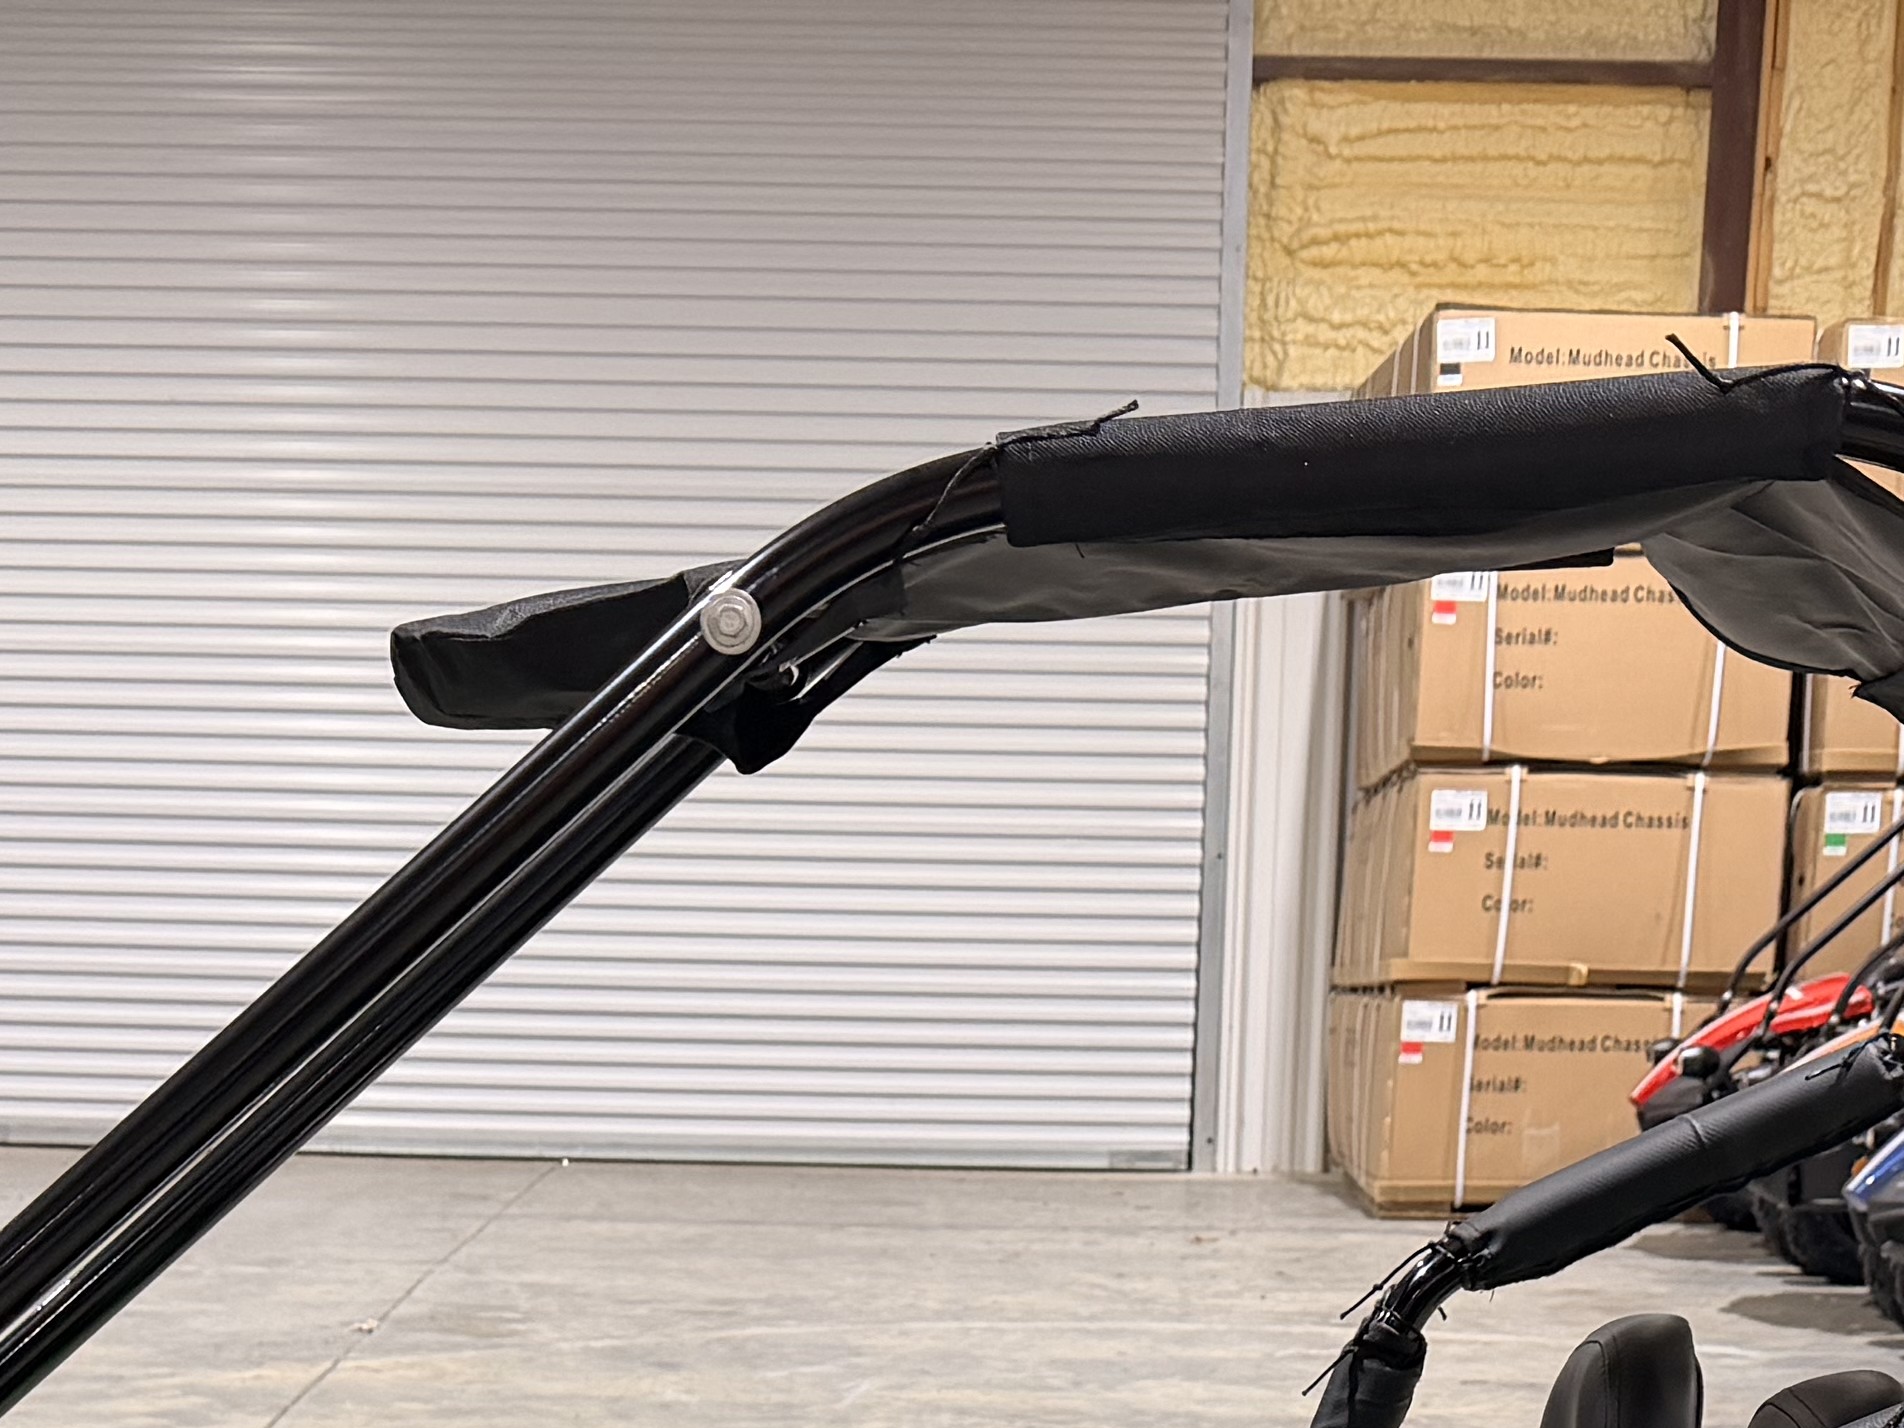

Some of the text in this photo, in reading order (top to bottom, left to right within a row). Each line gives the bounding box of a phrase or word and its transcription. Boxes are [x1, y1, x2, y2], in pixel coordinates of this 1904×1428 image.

[1634, 586, 1678, 605] Chas
[1493, 671, 1543, 690] Color:
[1623, 811, 1690, 830] Chassis
[1482, 895, 1534, 913] Coor:
